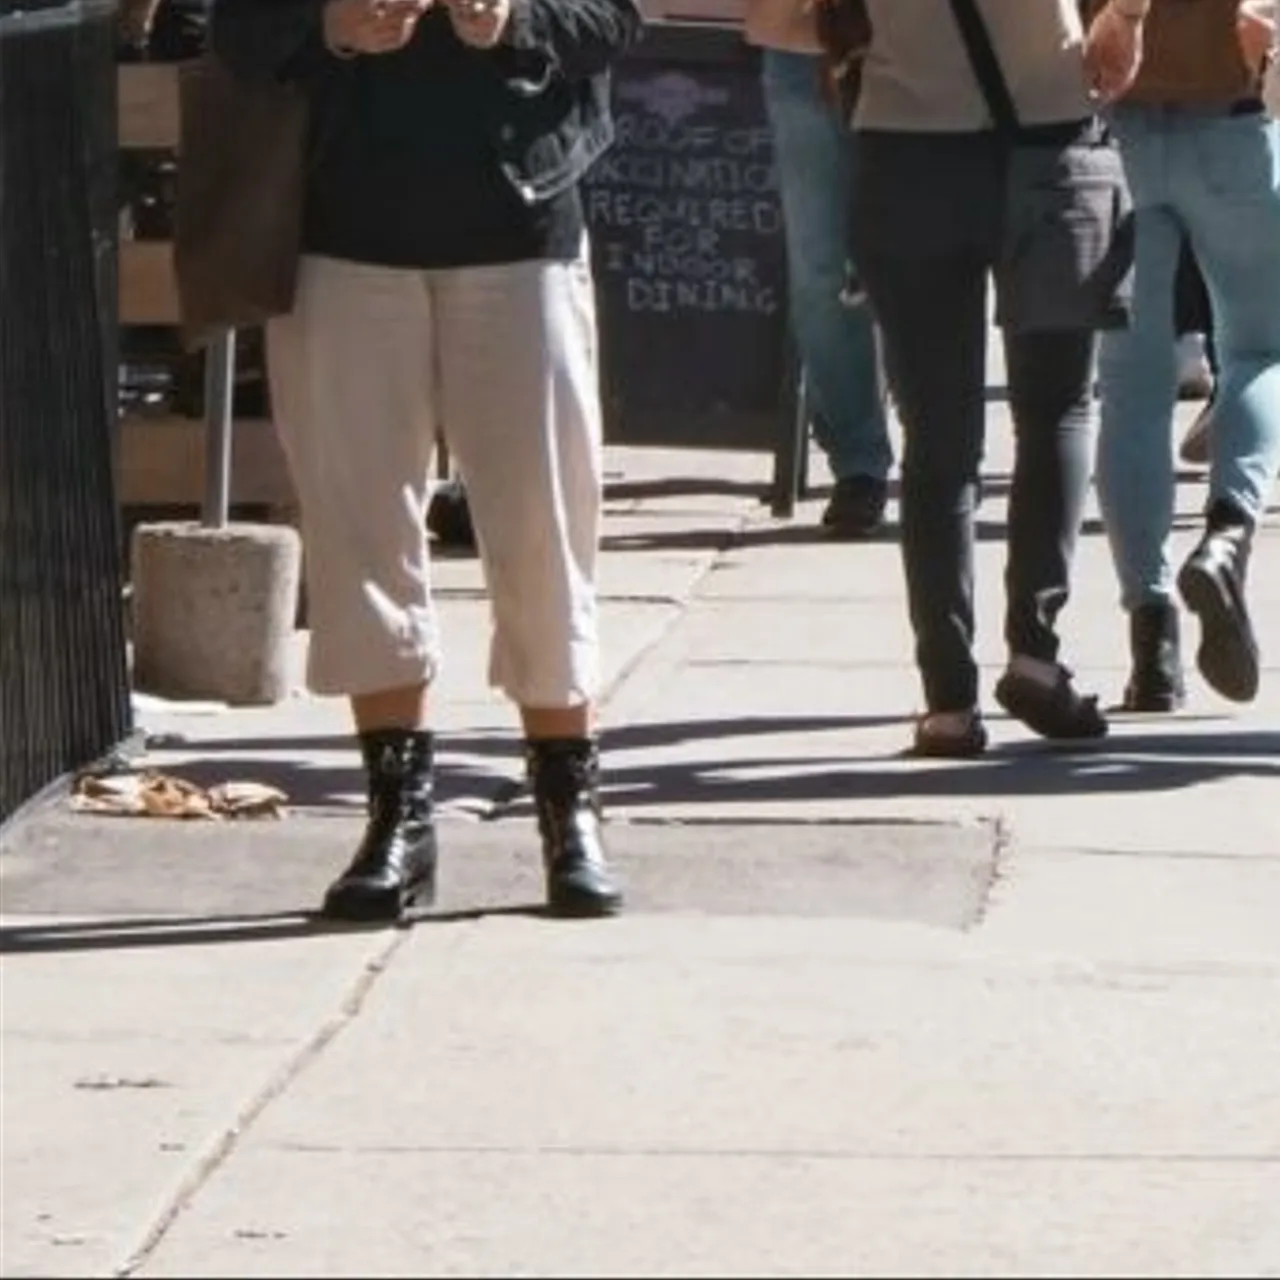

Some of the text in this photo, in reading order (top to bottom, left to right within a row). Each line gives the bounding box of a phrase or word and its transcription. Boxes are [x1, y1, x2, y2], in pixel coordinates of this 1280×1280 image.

[590, 189, 779, 233] REQUIRED
[643, 224, 720, 257] FOR
[628, 277, 777, 315] DINING
